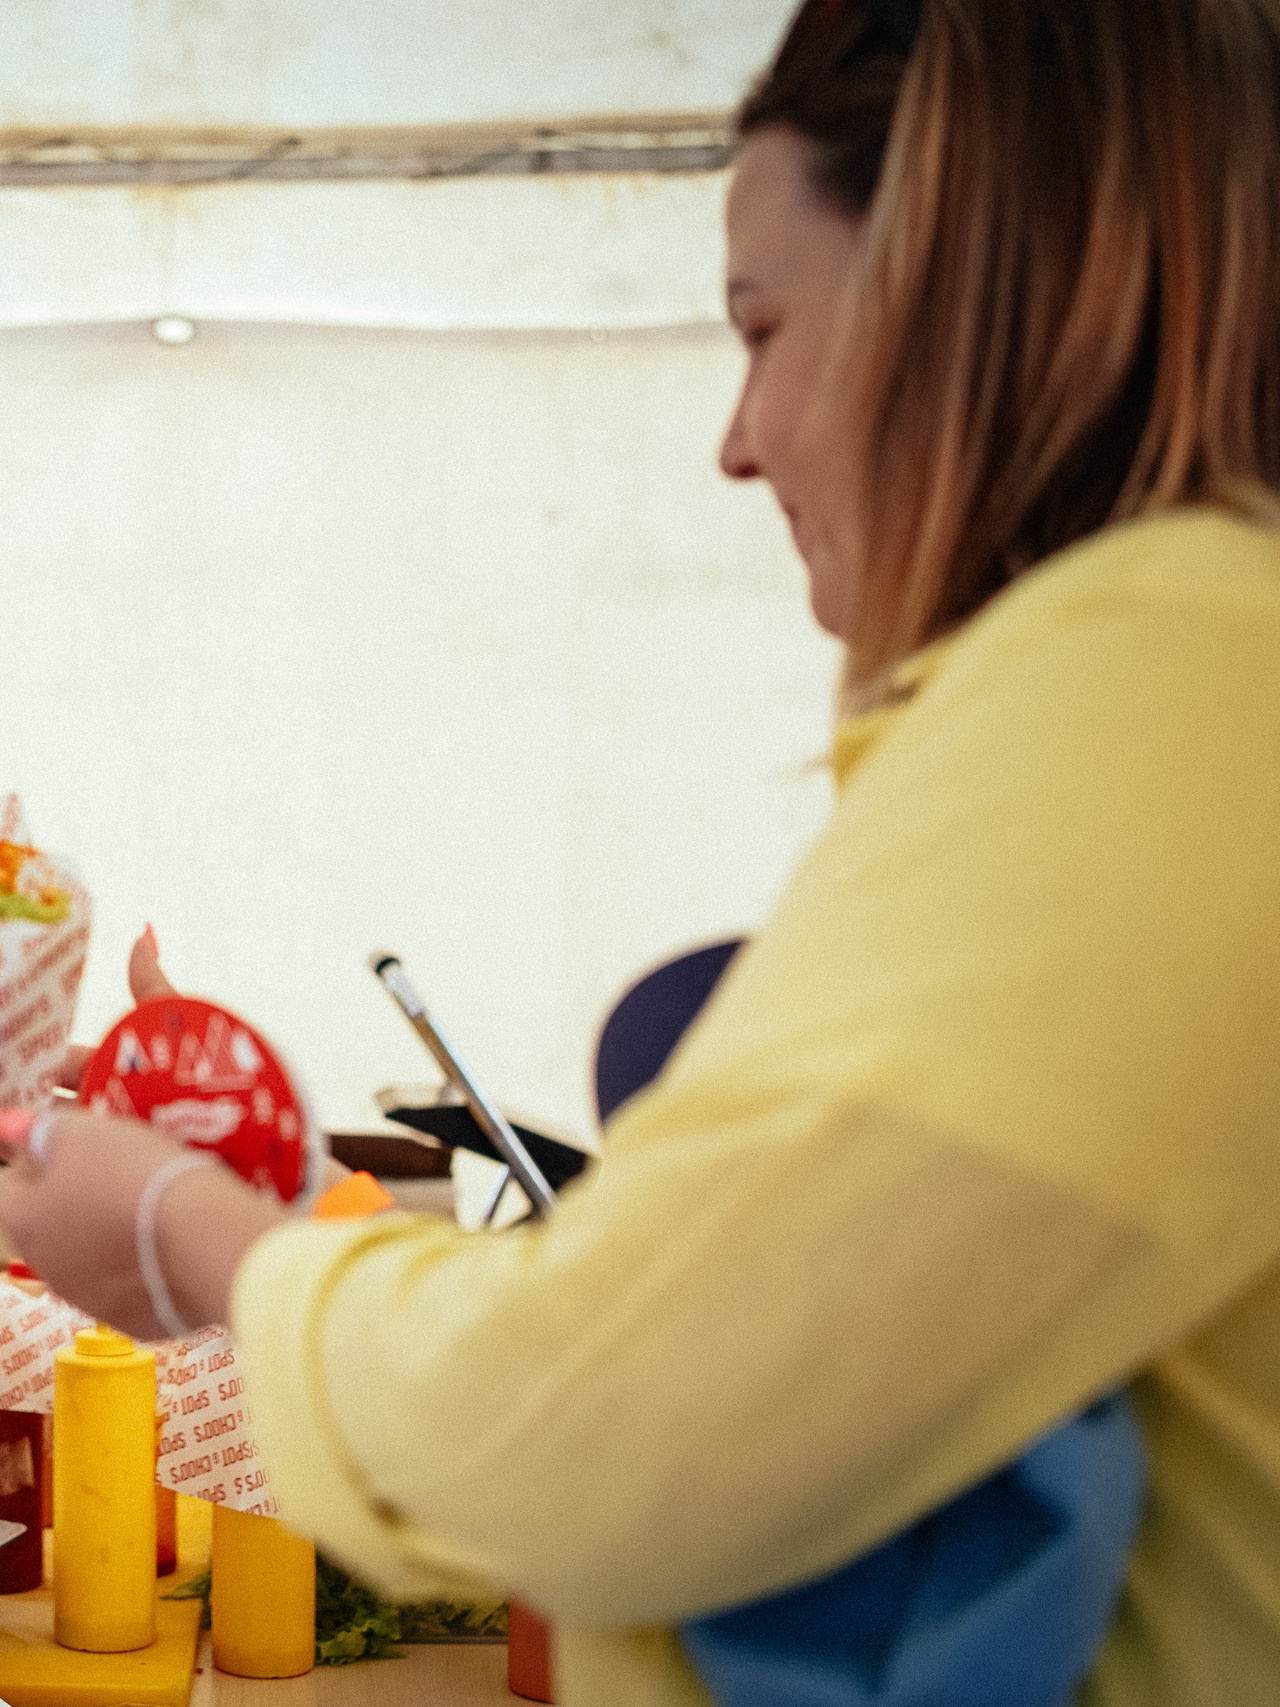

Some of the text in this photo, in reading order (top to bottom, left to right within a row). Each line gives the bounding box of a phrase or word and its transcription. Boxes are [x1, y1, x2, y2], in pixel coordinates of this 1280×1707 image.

[208, 1348, 236, 1373] SPOT
[181, 1389, 211, 1416] SPOT
[193, 1413, 237, 1443] CHOO'S
[169, 1455, 213, 1484] CHOO'S
